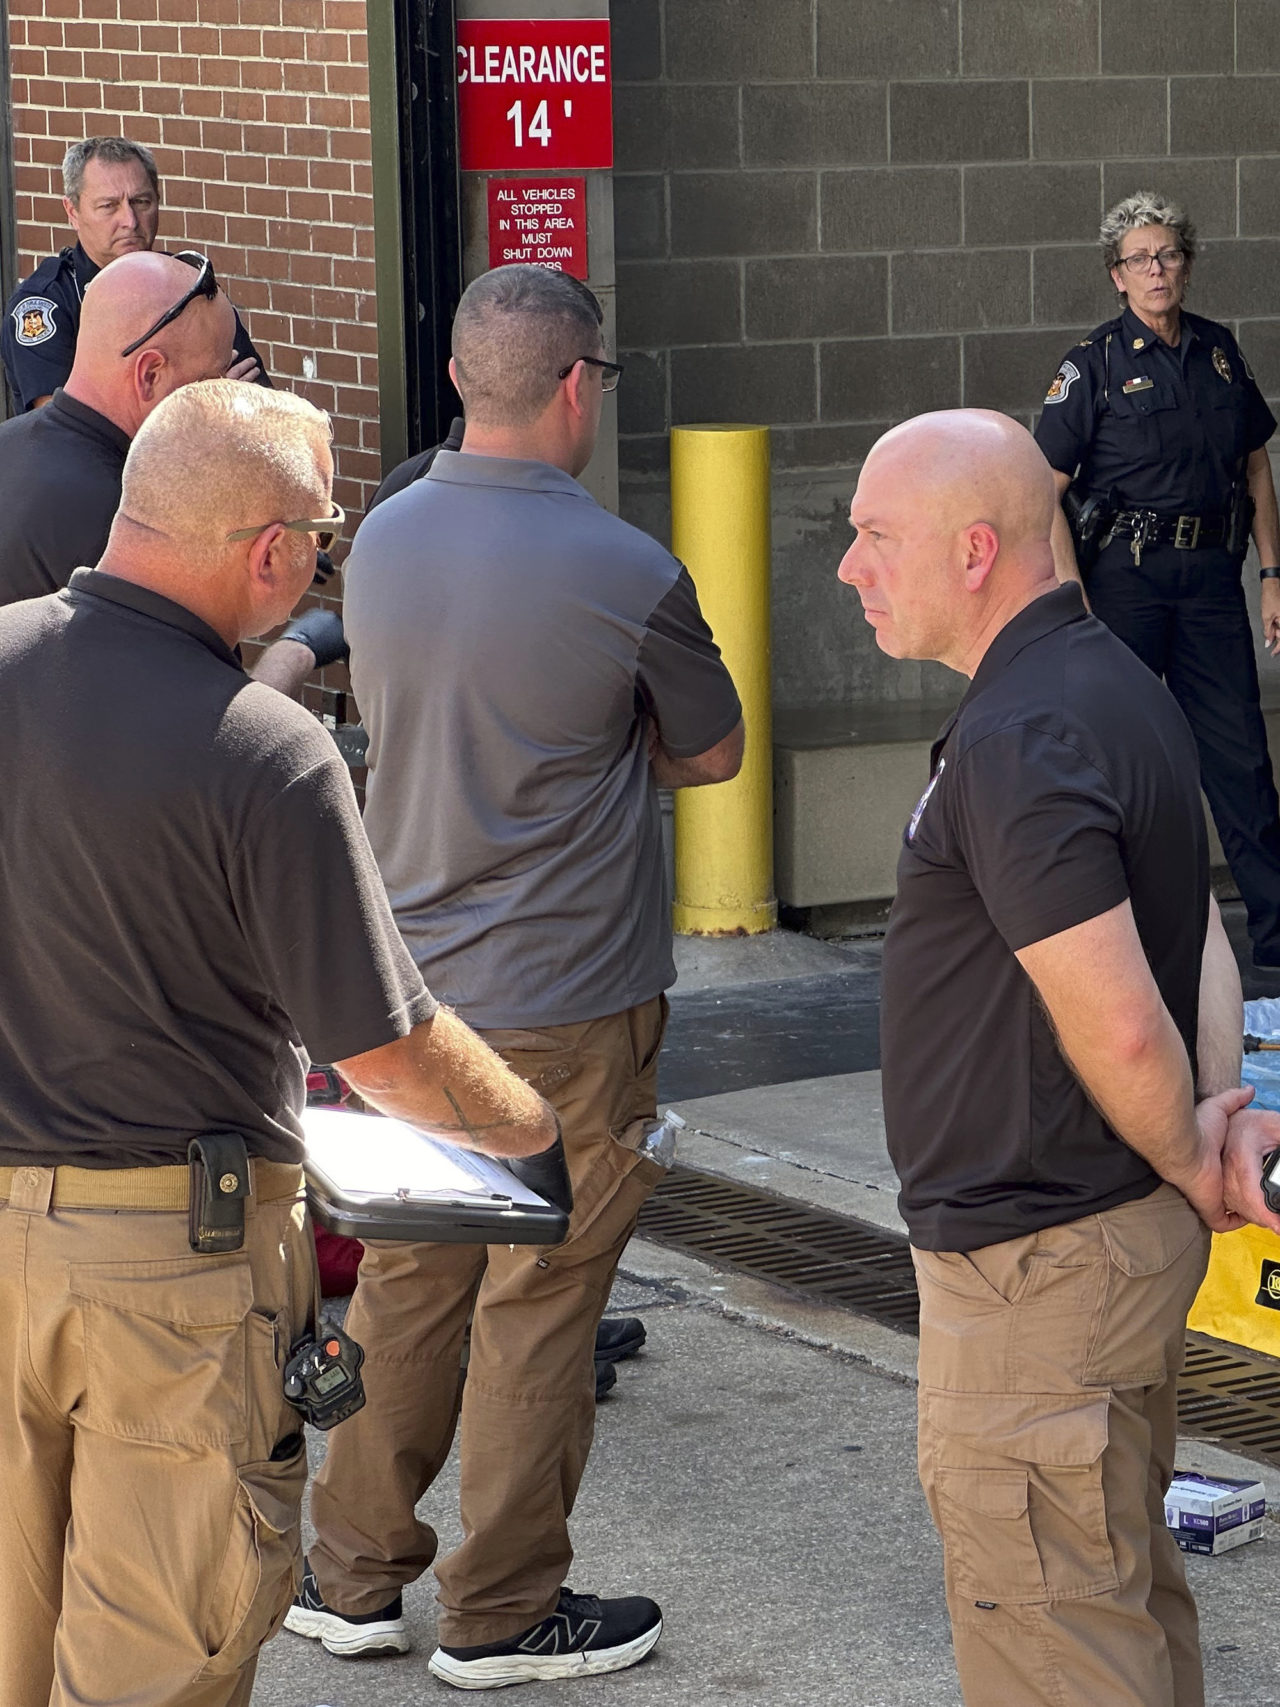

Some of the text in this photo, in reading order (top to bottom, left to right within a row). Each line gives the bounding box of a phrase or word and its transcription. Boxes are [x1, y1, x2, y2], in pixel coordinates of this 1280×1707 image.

[457, 45, 606, 83] CLEARANCE
[497, 188, 576, 201] ALL VEHICLES
[510, 203, 562, 215] STOPPED
[499, 218, 574, 230] IN THIS AREA
[521, 232, 553, 244] MUST
[503, 246, 573, 259] SHUT DOWN
